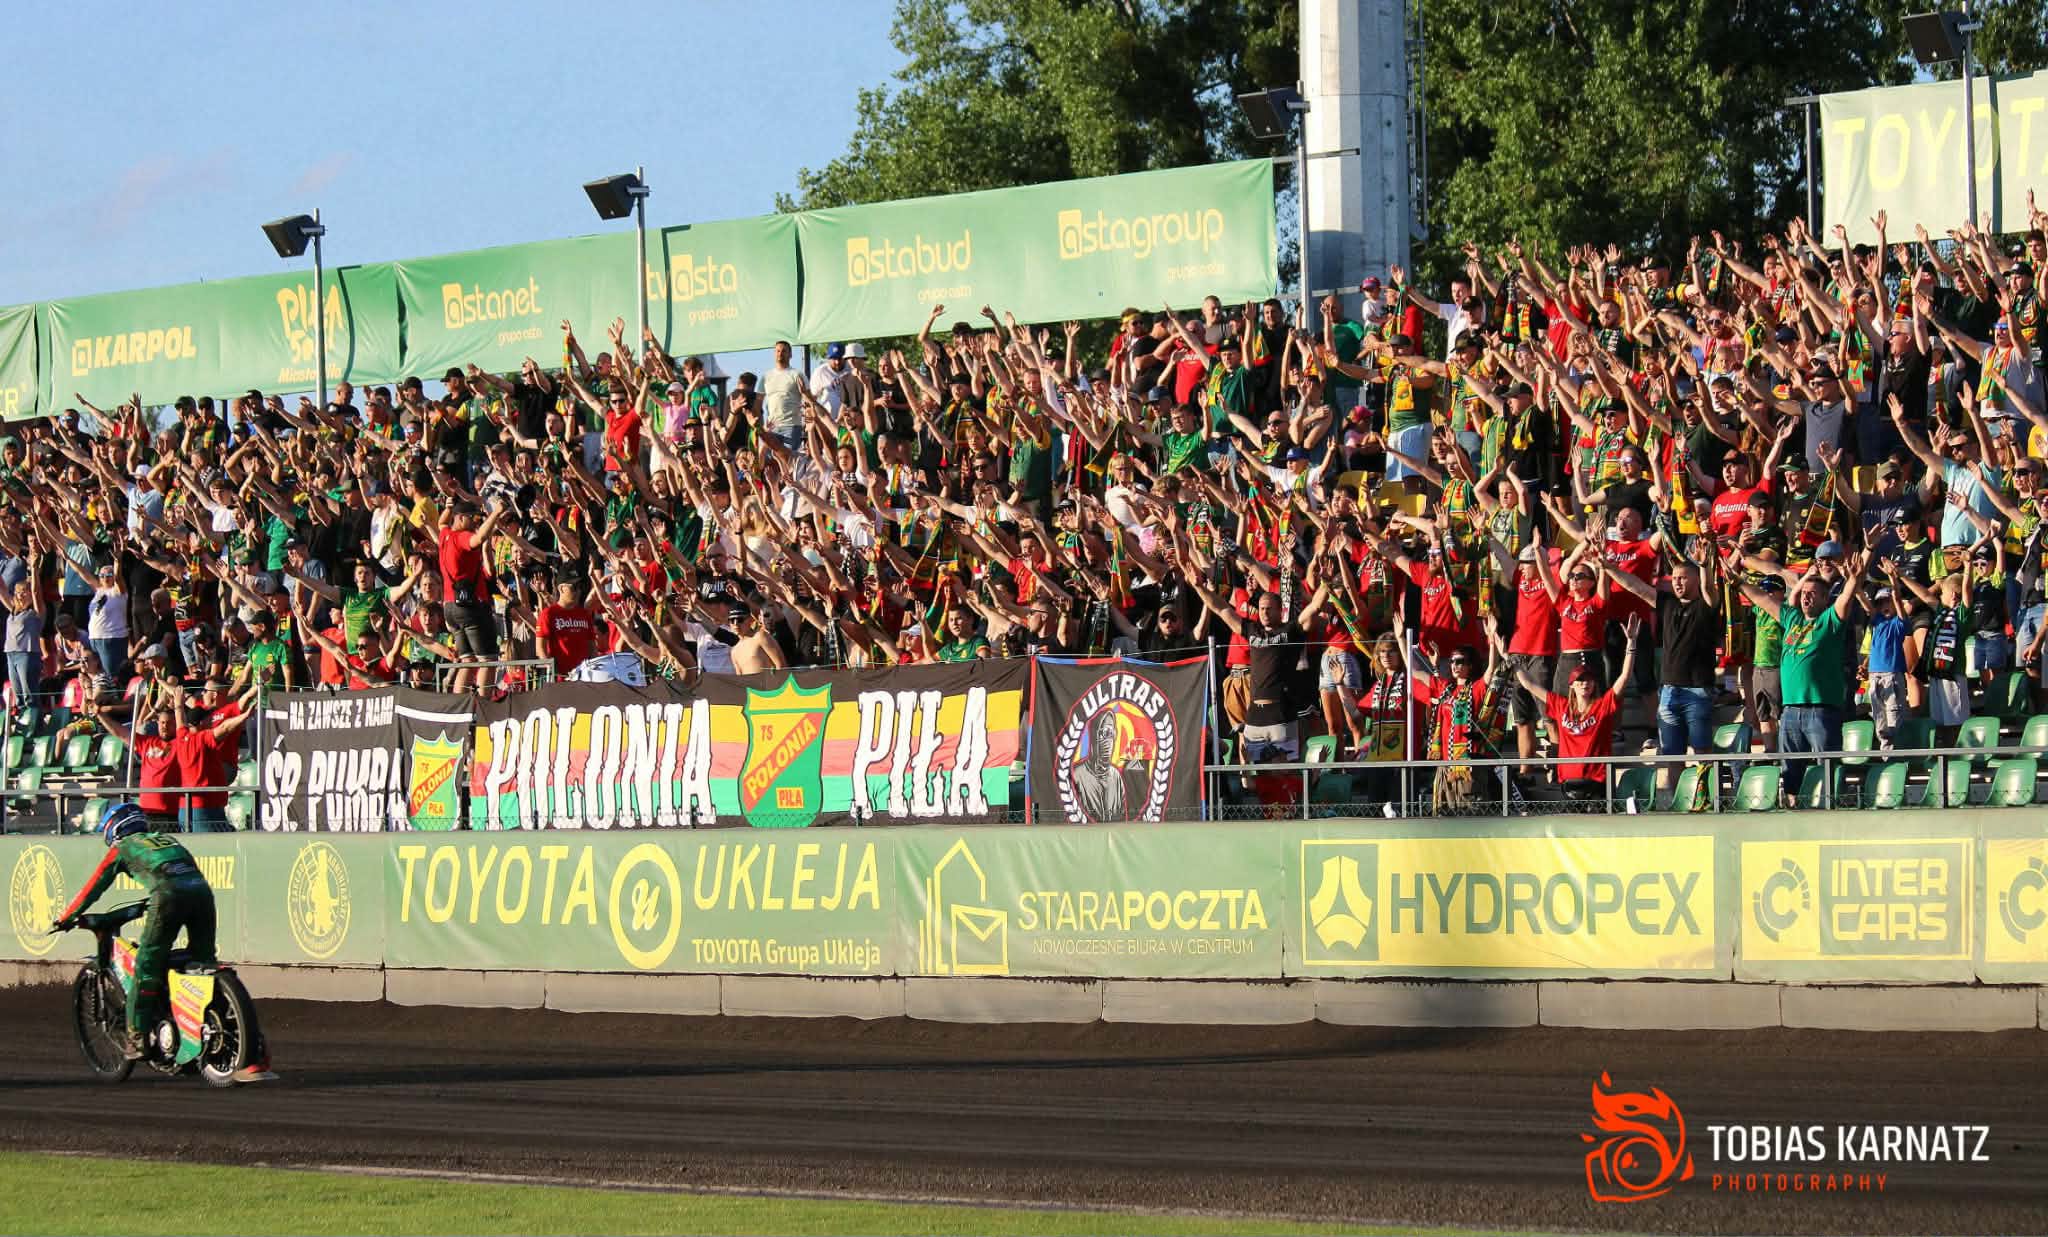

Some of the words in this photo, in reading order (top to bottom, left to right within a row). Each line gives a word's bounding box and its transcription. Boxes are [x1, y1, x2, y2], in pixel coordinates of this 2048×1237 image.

[1831, 97, 2048, 194] TOYOT
[847, 230, 972, 287] astabud
[441, 275, 544, 329] astanet
[94, 327, 197, 368] KARPOL
[289, 701, 305, 730] NA
[307, 700, 353, 730] ZAWSZE
[354, 699, 363, 728] Z
[1081, 674, 1166, 718] ULTRAS
[760, 725, 774, 742] TS
[850, 686, 989, 821] PIŁA
[484, 698, 717, 831] POLONIA
[745, 717, 818, 800] POLONIA
[399, 845, 597, 925] TOYOTA
[693, 843, 880, 910] UKLEJA
[1831, 858, 1949, 897] INTER
[1017, 888, 1268, 931] STARAPOCZTA
[1391, 872, 1702, 936] HYDROPEX
[1831, 903, 1948, 941] CARS
[691, 938, 762, 964] TOYOTA
[765, 938, 820, 971] Grupa
[823, 938, 881, 971] Ukleja
[1032, 938, 1124, 955] NOWOCZESNE
[1127, 938, 1166, 954] BIURA
[1169, 938, 1184, 954] W
[1187, 938, 1254, 955] CENTRUM
